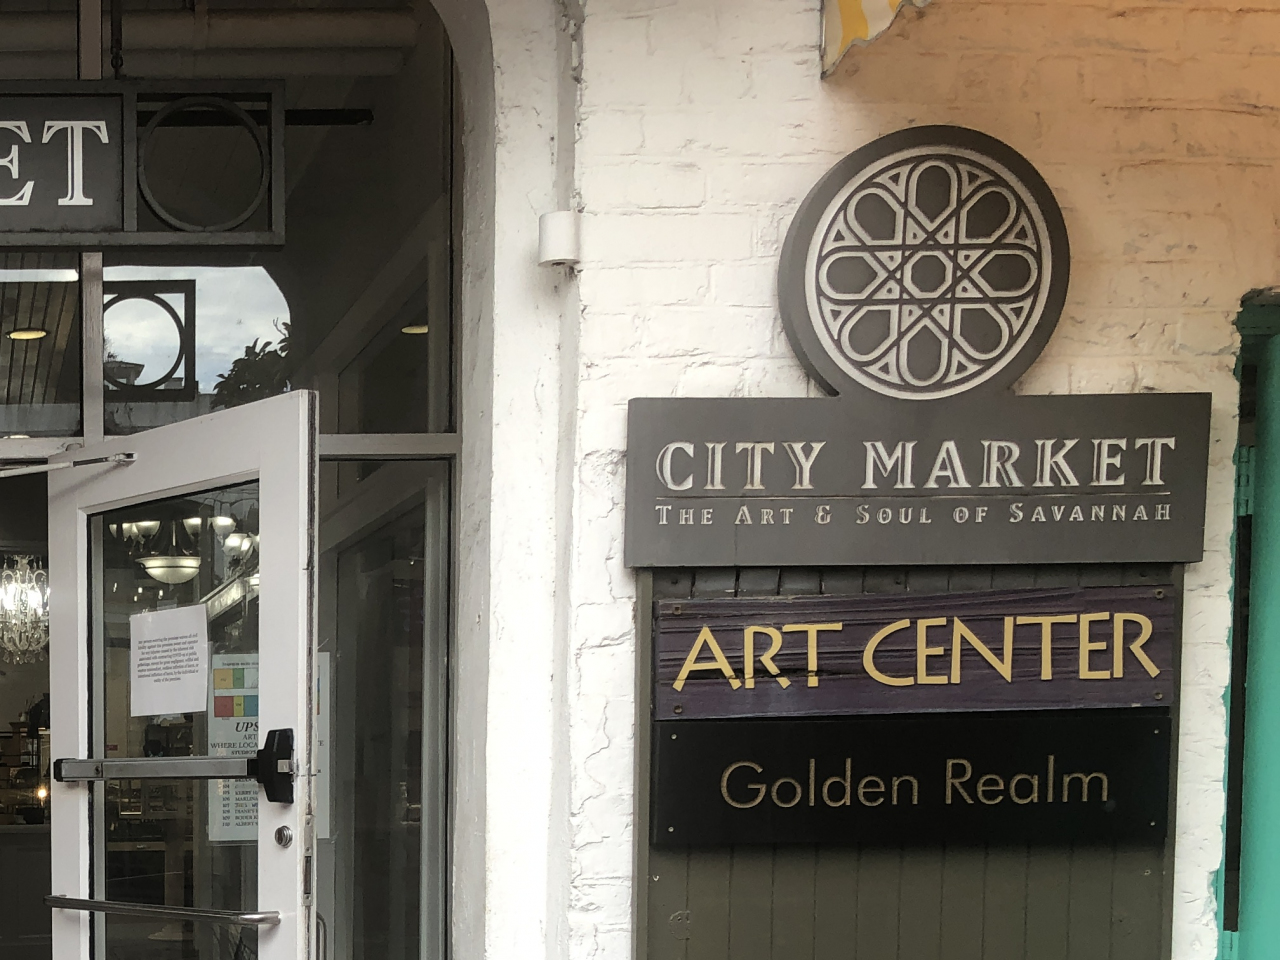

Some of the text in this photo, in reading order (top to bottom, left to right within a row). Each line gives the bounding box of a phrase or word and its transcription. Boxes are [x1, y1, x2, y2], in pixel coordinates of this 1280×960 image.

[655, 436, 1176, 491] CITY MARKET
[814, 504, 832, 525] &
[672, 611, 1162, 692] ART CENTER
[720, 754, 1109, 809] Golden Realm
